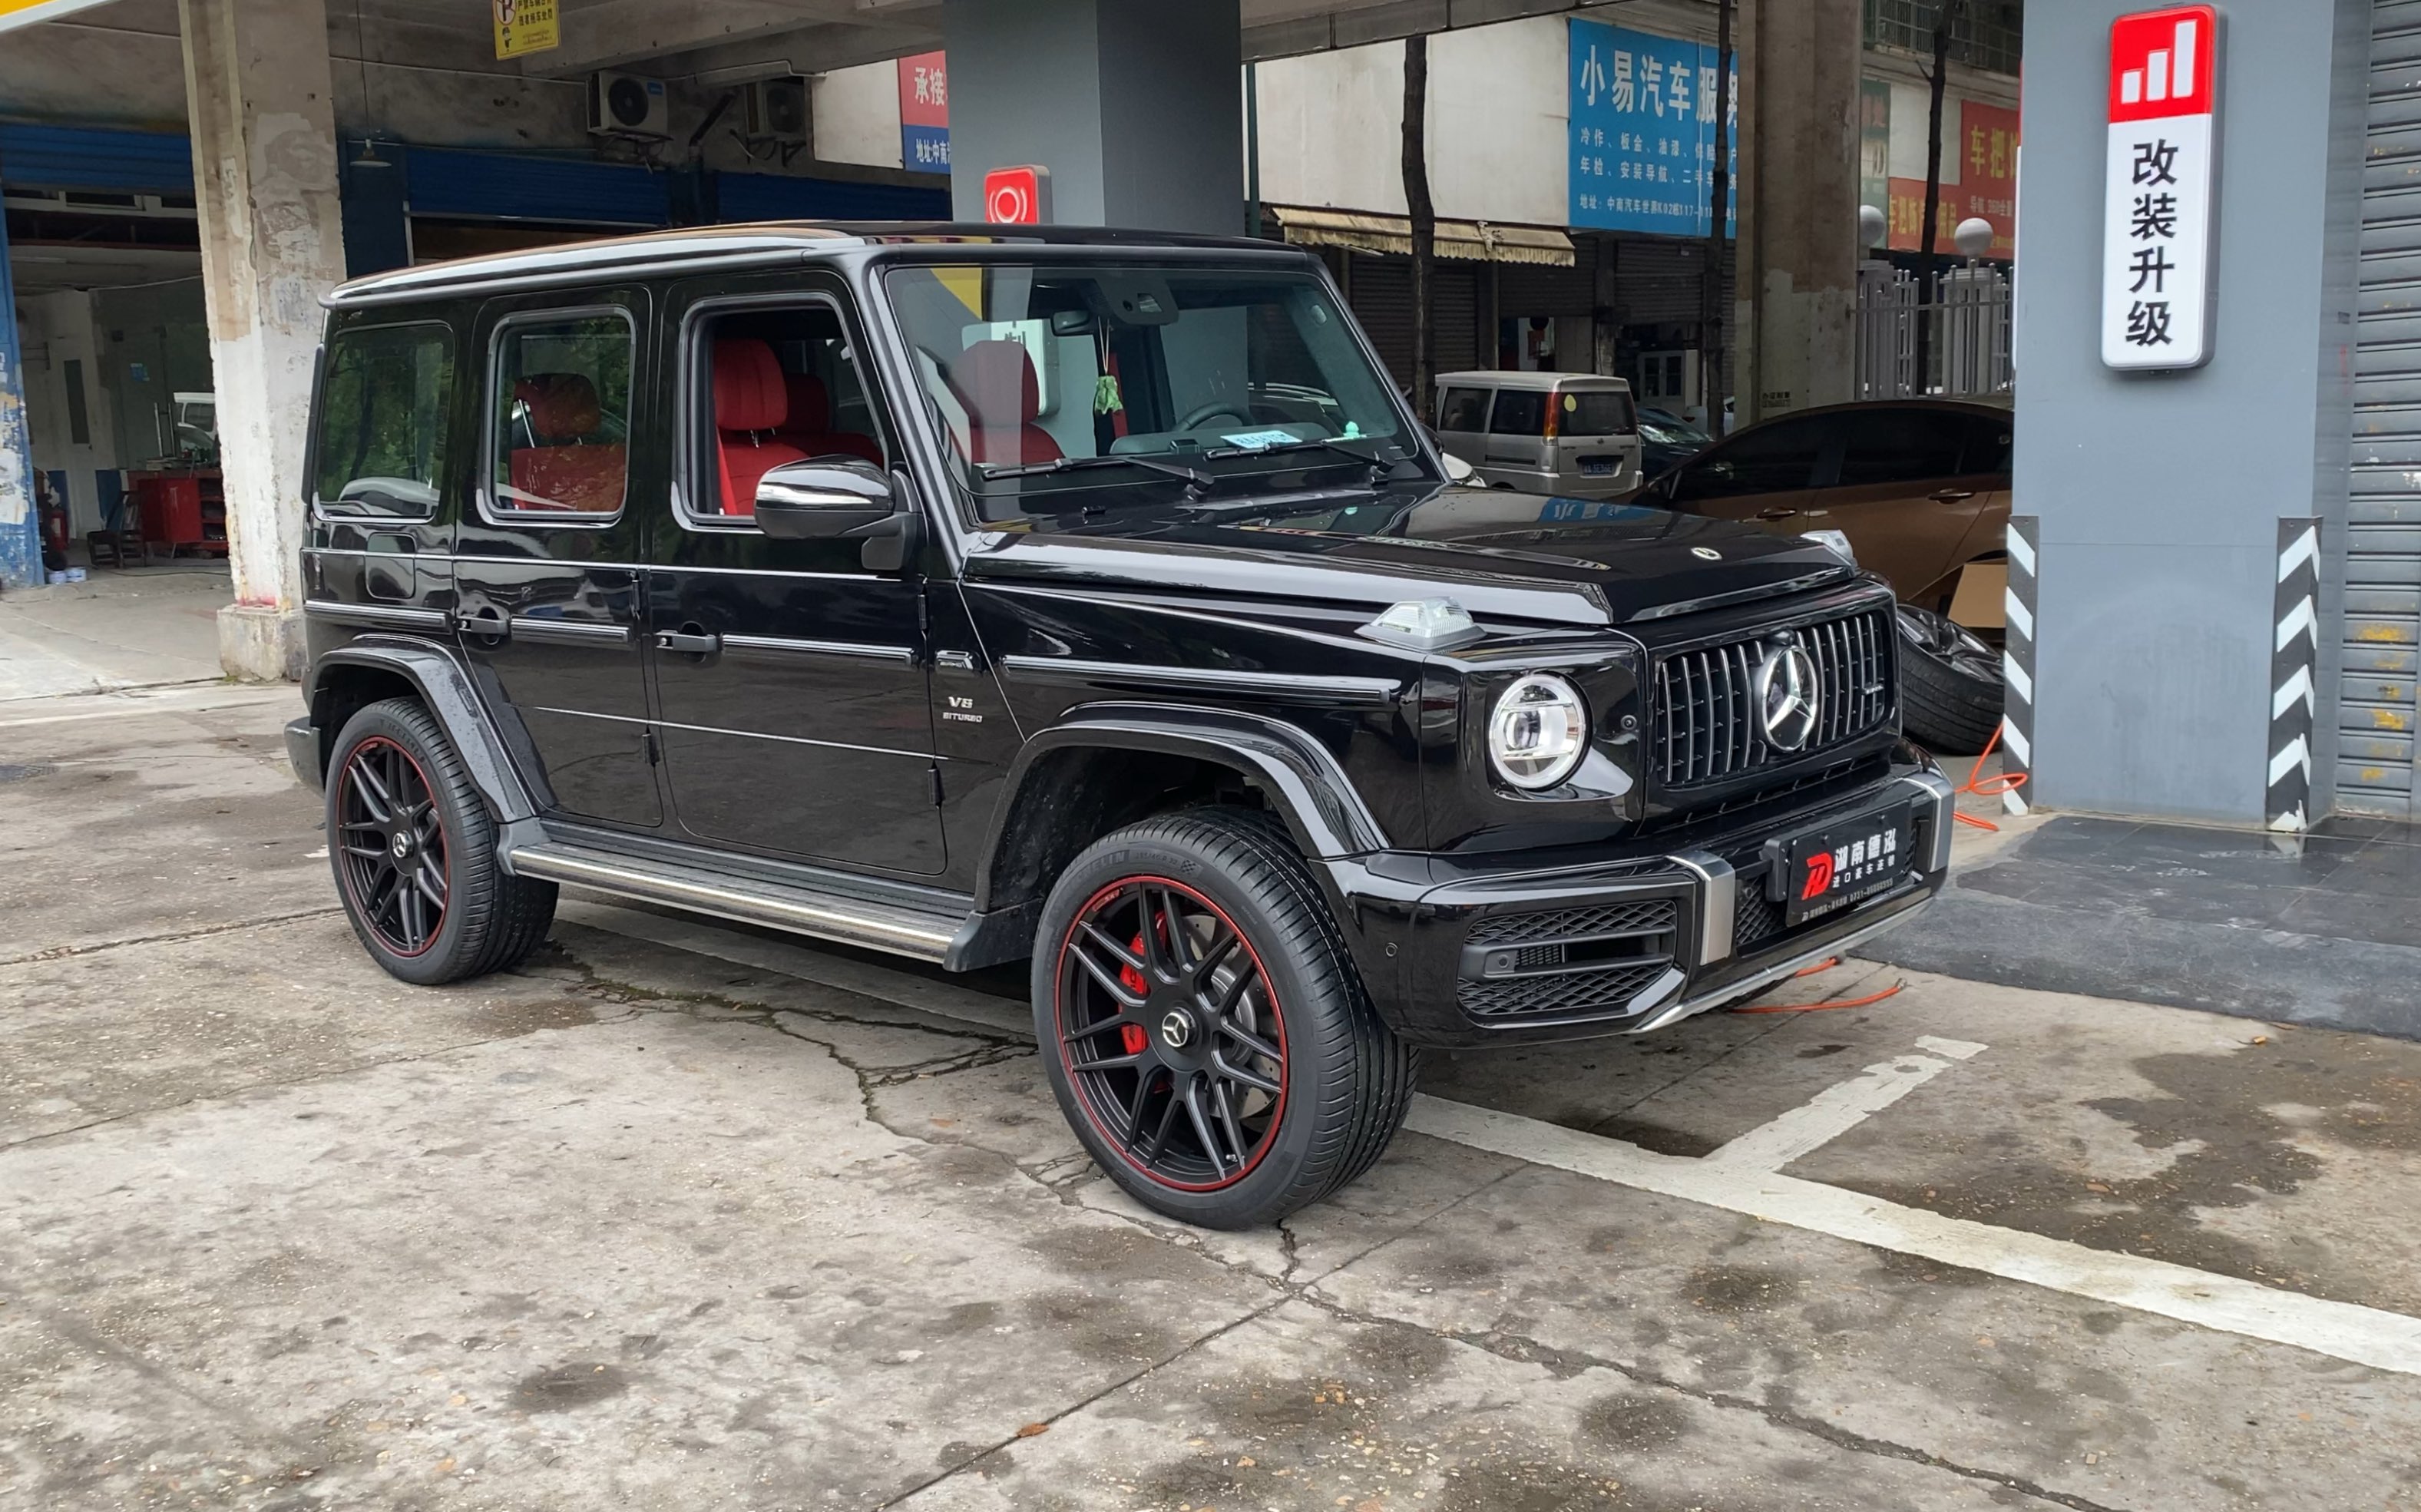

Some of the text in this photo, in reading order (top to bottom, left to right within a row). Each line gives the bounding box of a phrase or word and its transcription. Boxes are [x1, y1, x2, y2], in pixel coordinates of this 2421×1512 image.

[914, 66, 948, 106] 承接
[2125, 138, 2179, 347] 改装升级
[948, 696, 973, 709] V8
[943, 712, 983, 723] BITURBO
